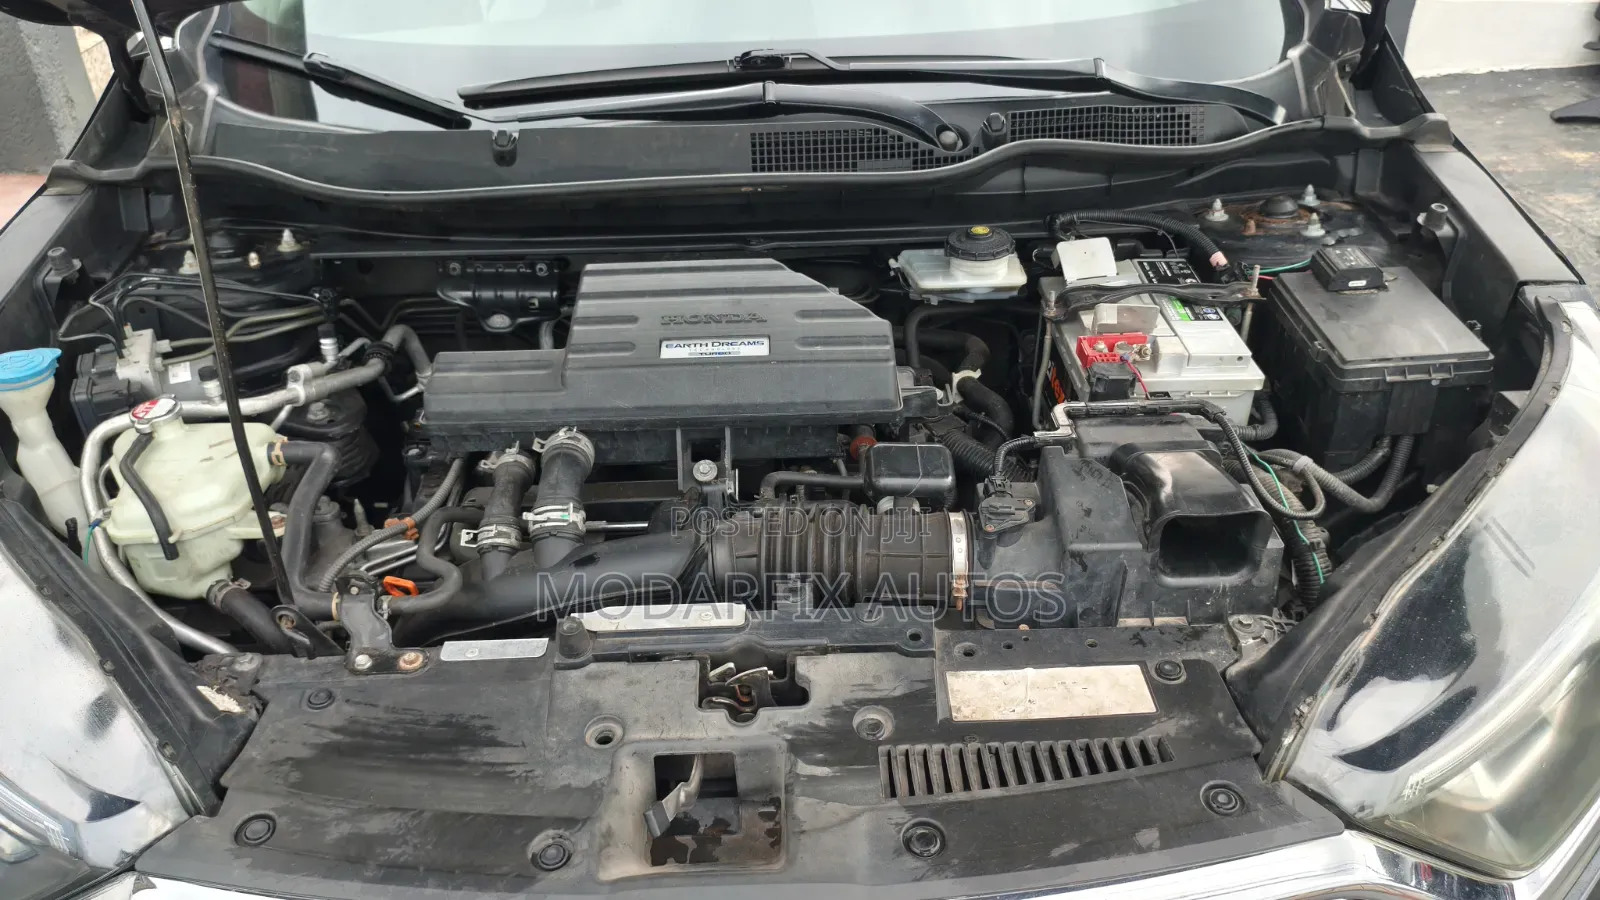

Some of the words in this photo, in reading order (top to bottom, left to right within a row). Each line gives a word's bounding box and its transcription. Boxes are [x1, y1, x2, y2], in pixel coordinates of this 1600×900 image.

[660, 312, 768, 326] HONDA
[665, 341, 709, 349] EARTH
[711, 340, 765, 348] DREAMS
